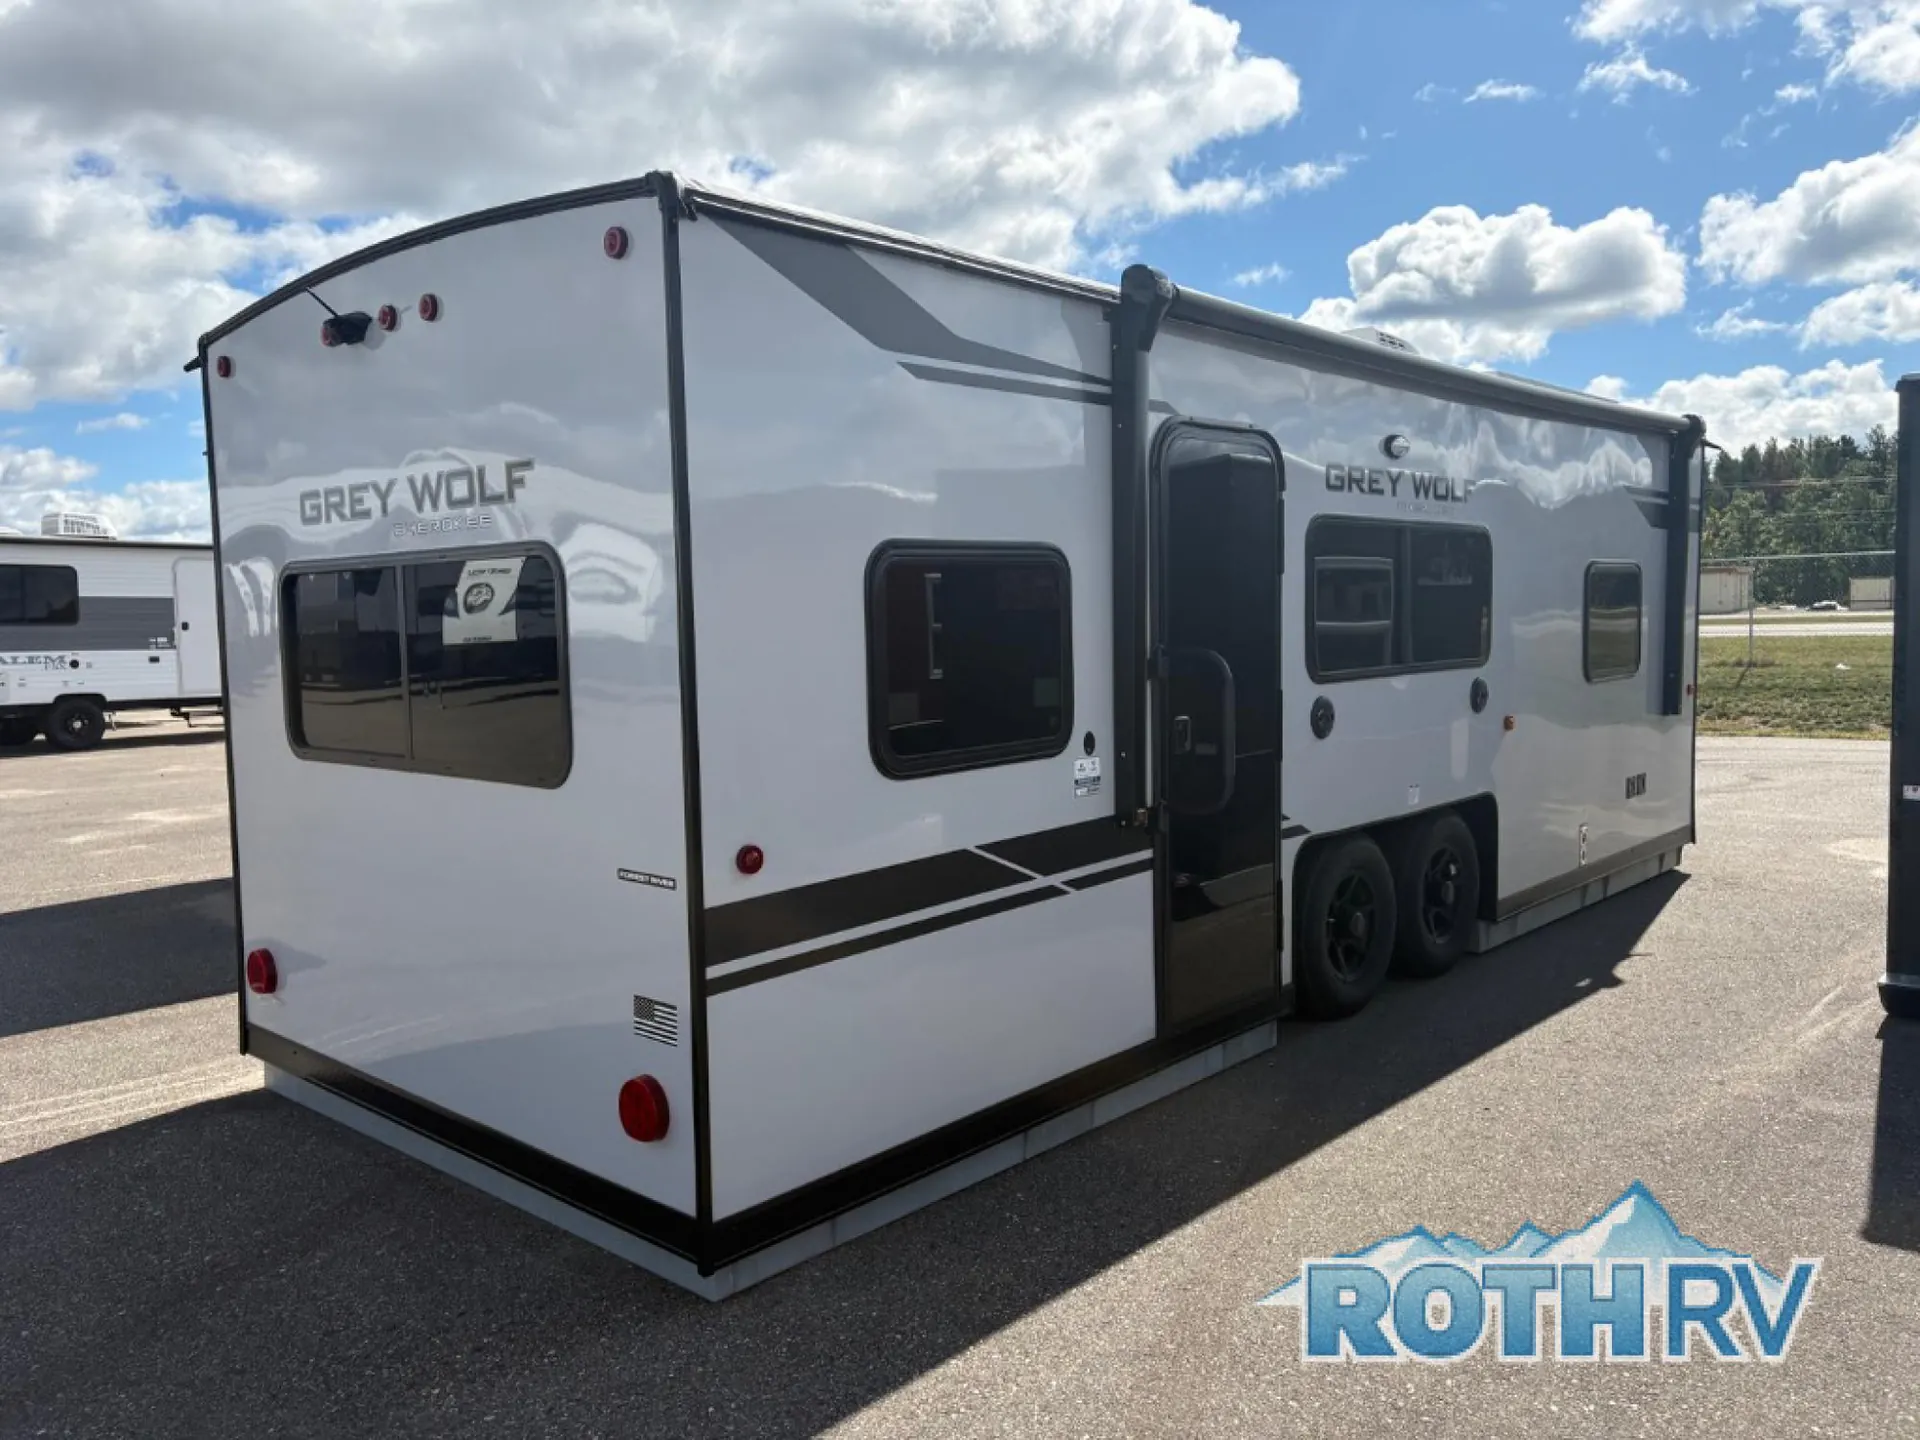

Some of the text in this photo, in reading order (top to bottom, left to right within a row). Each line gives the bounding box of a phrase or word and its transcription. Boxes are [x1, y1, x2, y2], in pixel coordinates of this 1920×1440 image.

[299, 457, 535, 526] GREY WOLF
[1325, 463, 1477, 504] GREY WOLF
